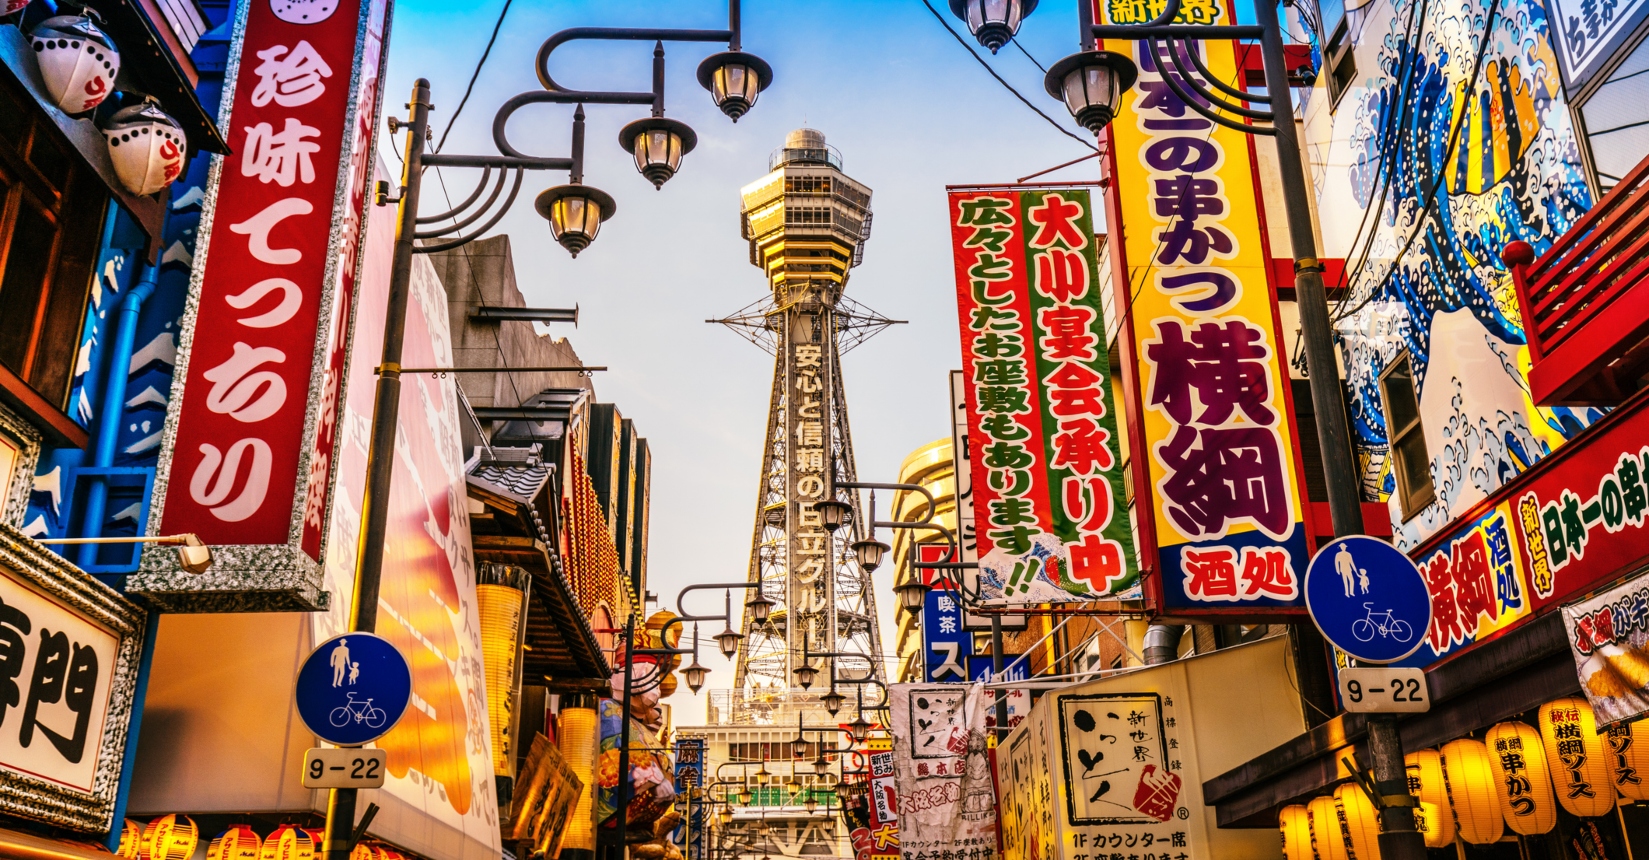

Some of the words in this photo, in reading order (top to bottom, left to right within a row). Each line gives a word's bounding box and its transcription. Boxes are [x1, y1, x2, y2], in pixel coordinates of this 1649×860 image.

[1137, 38, 1238, 312] 日本一の串かつ
[188, 39, 333, 523] 珍味てっちり
[1031, 195, 1123, 594] 大小宴会承り中
[1146, 319, 1291, 537] 横綱
[1542, 452, 1649, 567] 日本一の串
[1484, 515, 1522, 616] 酒処
[1520, 495, 1552, 595] 新世界
[1185, 549, 1294, 597] 酒処
[937, 595, 957, 634] 喫茶
[930, 641, 966, 679] ス
[1346, 678, 1424, 704] 9-22
[1550, 709, 1580, 723] 秘伝
[870, 752, 893, 767] 新世
[1127, 709, 1154, 763] 新世界
[1495, 738, 1522, 751] 横綱
[1555, 723, 1596, 799] 横綱ソース
[308, 758, 381, 780] 9-22
[676, 740, 701, 788] 麻雀
[1501, 752, 1536, 816] 串かつ
[873, 779, 888, 821] 大阪名物
